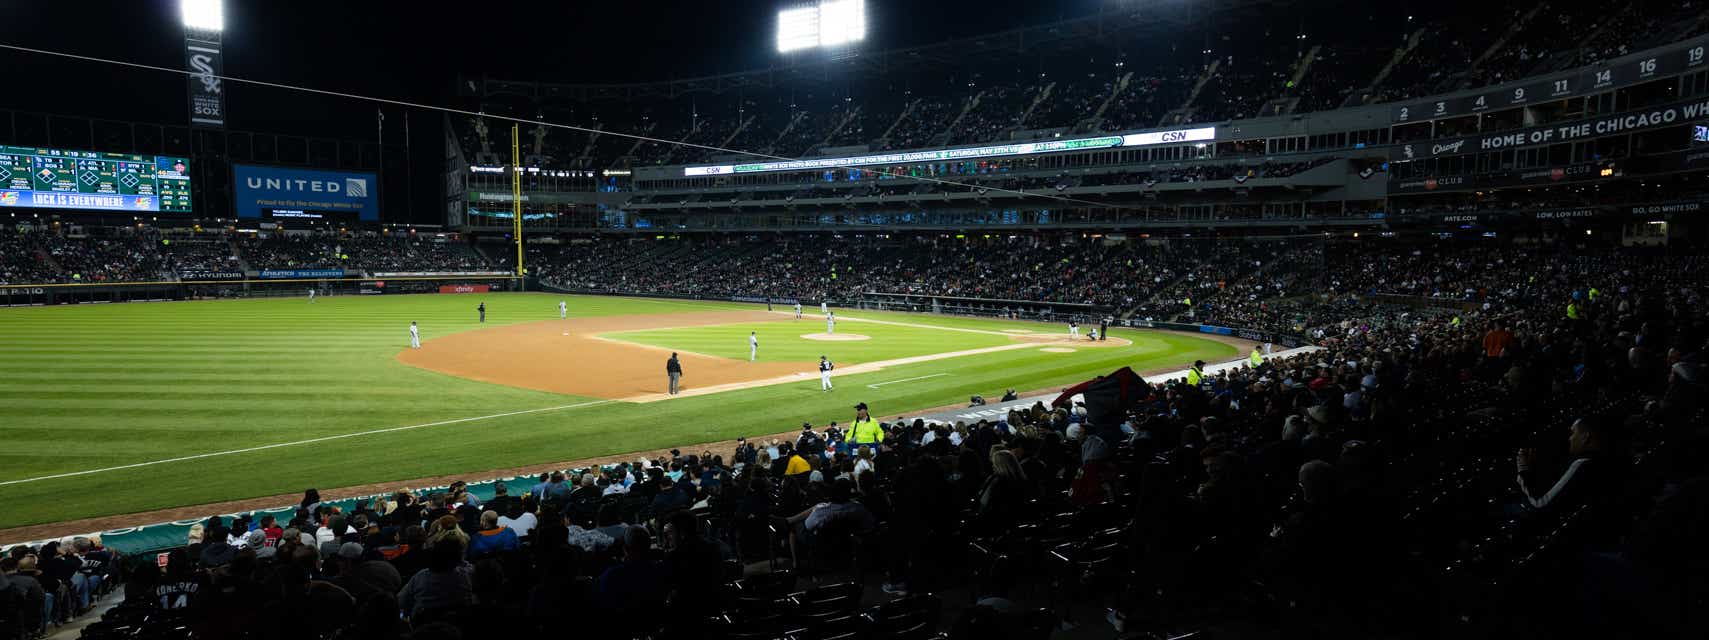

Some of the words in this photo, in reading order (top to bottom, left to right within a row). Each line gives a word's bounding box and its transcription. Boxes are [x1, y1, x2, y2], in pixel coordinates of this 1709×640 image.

[1688, 46, 1704, 62] 19
[1640, 58, 1656, 73] 16
[1595, 69, 1611, 83] 14
[1554, 80, 1568, 92] 11
[1514, 88, 1524, 100] 9
[1436, 102, 1446, 112] 3
[1476, 96, 1484, 106] 4
[194, 106, 220, 116] SOX
[1400, 107, 1408, 118] 2
[1481, 132, 1525, 150] HOME
[1530, 129, 1553, 143] OF
[1559, 124, 1591, 139] THE
[1596, 108, 1677, 134] CHICAGO
[1161, 131, 1187, 142] CSN
[247, 177, 340, 192] UNITED
[33, 194, 54, 205] LUCK
[69, 195, 124, 207] EVERYWHERE
